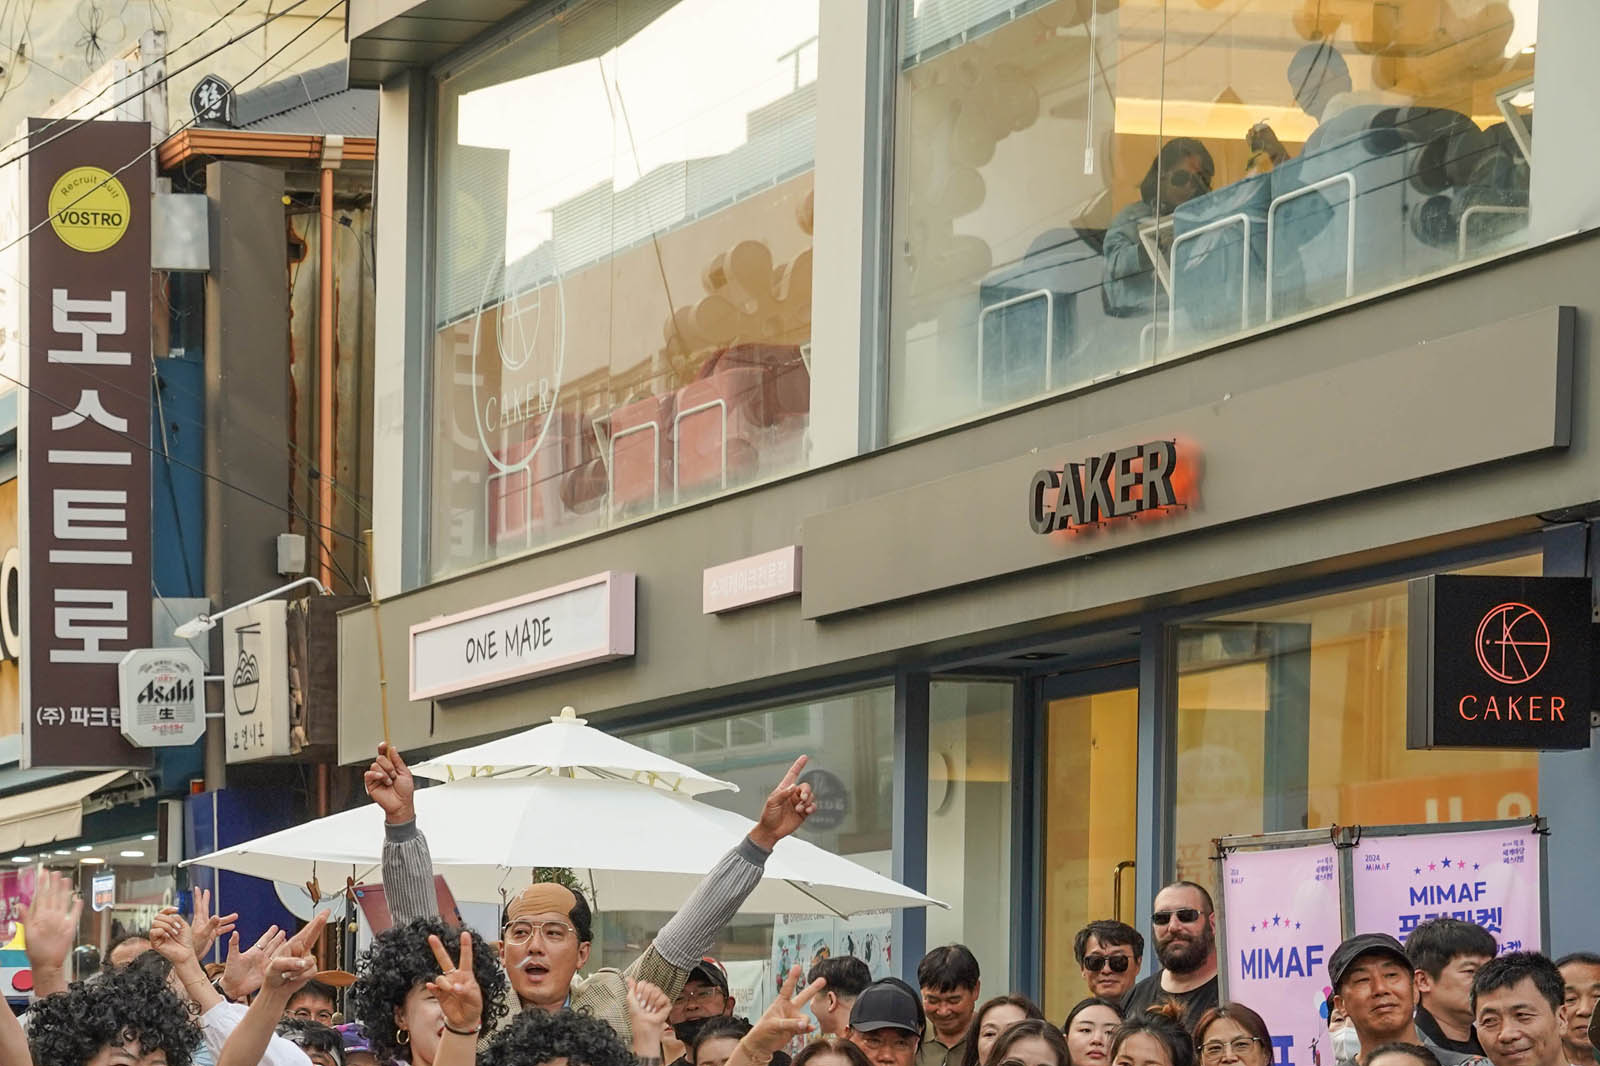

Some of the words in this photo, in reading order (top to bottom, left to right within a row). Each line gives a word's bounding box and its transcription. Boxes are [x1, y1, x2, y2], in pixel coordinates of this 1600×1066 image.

[60, 175, 98, 197] Recruit
[58, 211, 123, 227] VOSTRO
[485, 377, 550, 433] CAKER
[48, 288, 133, 664] 보스트로
[1029, 440, 1177, 534] CAKER
[466, 630, 498, 664] ONE
[504, 616, 553, 657] MADE
[137, 678, 195, 704] Asahi
[36, 706, 66, 728] (주)
[1458, 694, 1566, 721] CAKER
[1365, 855, 1380, 863] 2024
[1365, 862, 1391, 871] MIMAF
[1409, 882, 1487, 906] MIMAF
[1241, 944, 1324, 979] MIMAF
